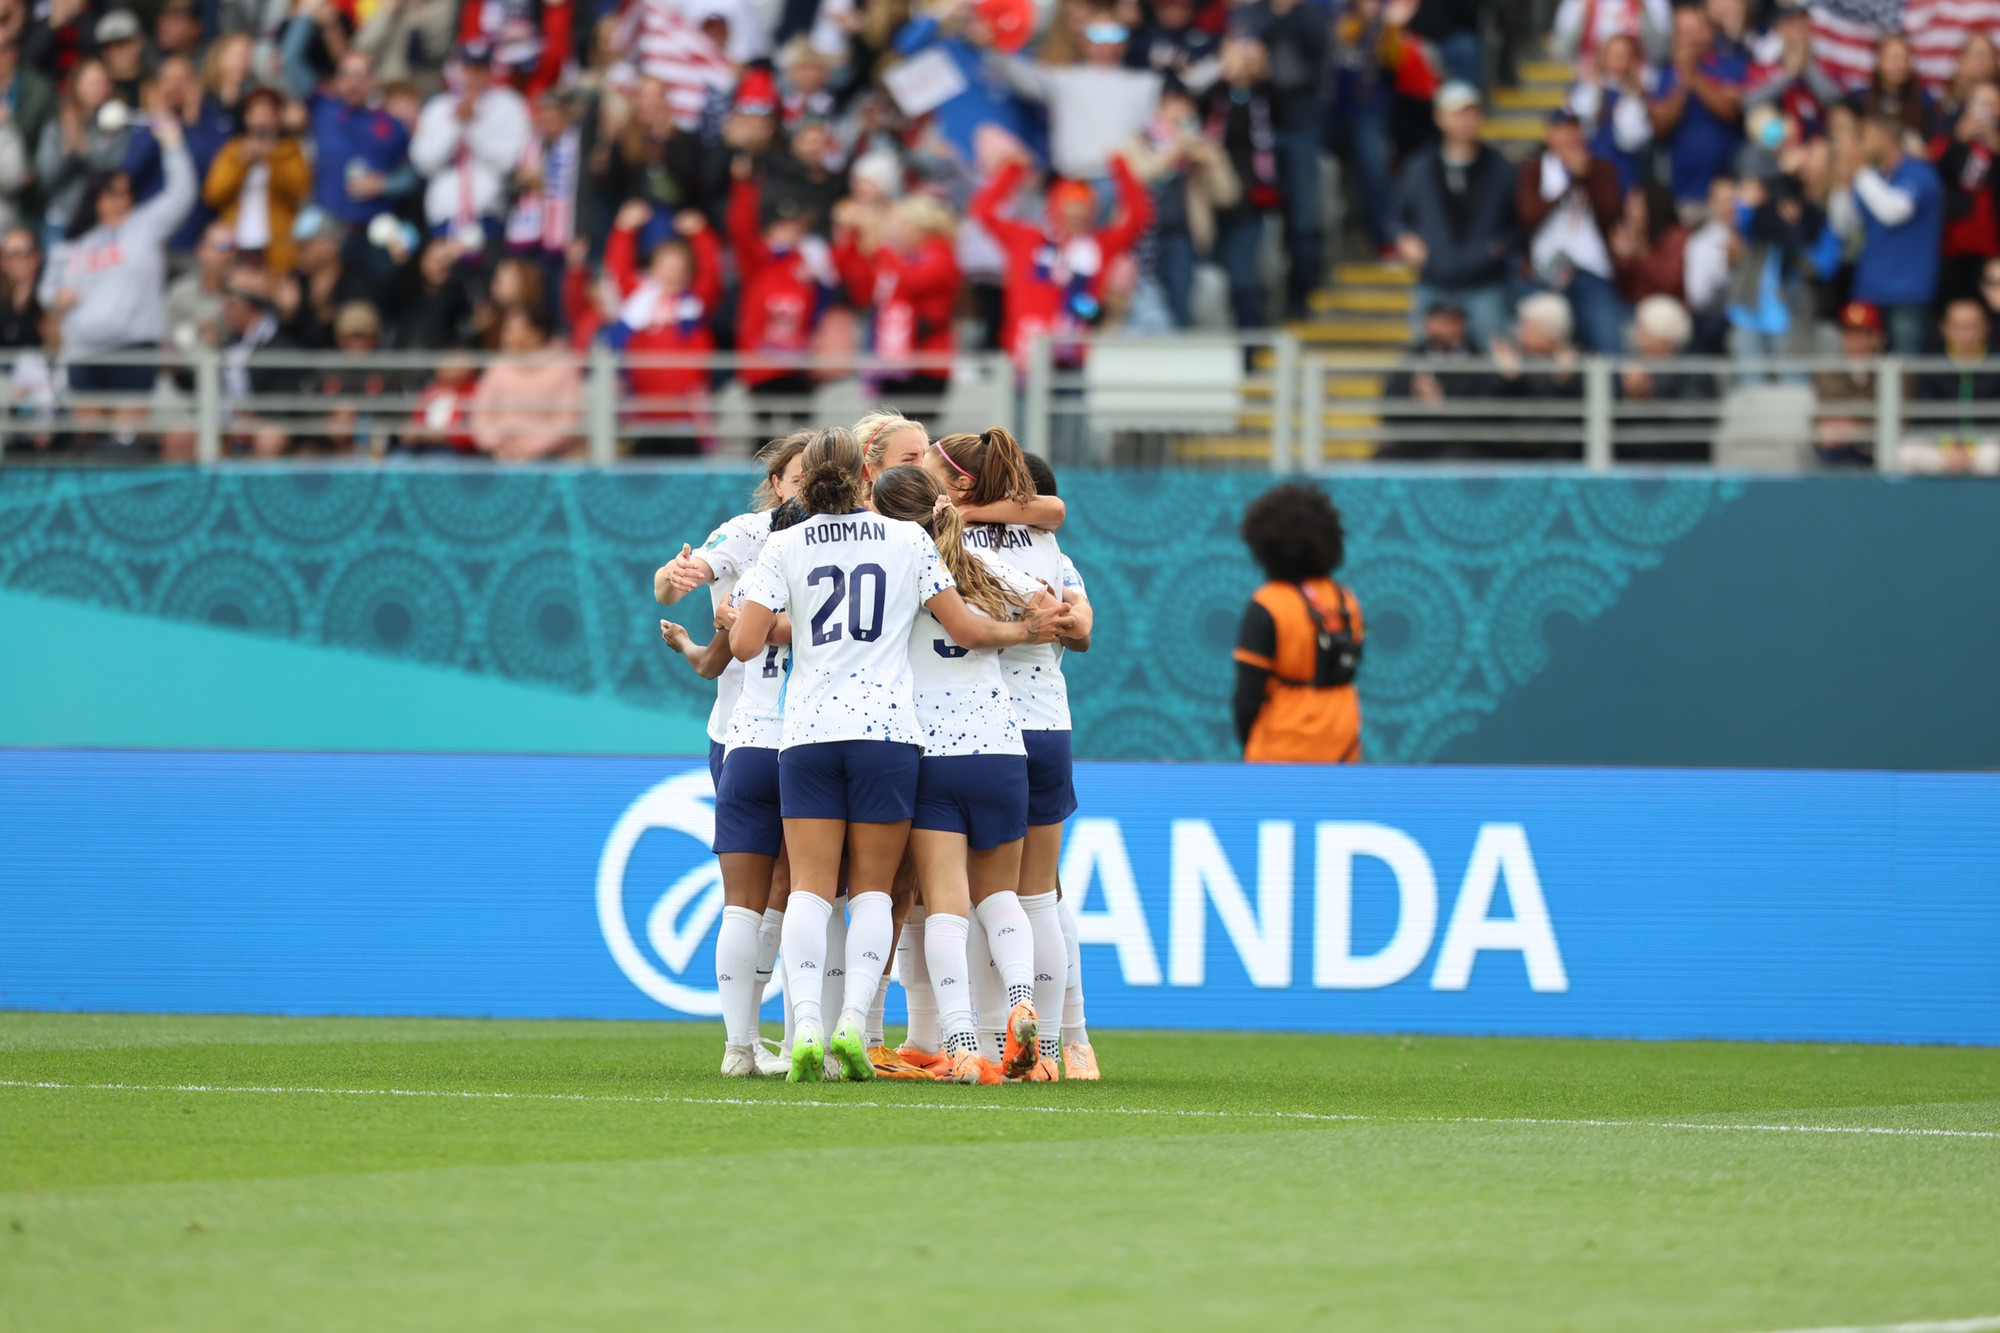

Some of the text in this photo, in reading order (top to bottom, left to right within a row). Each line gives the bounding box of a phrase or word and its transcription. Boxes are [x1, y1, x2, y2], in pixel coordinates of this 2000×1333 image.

[804, 521, 886, 546] RODMAN
[807, 563, 887, 646] 20
[1058, 818, 1570, 992] ANDA
